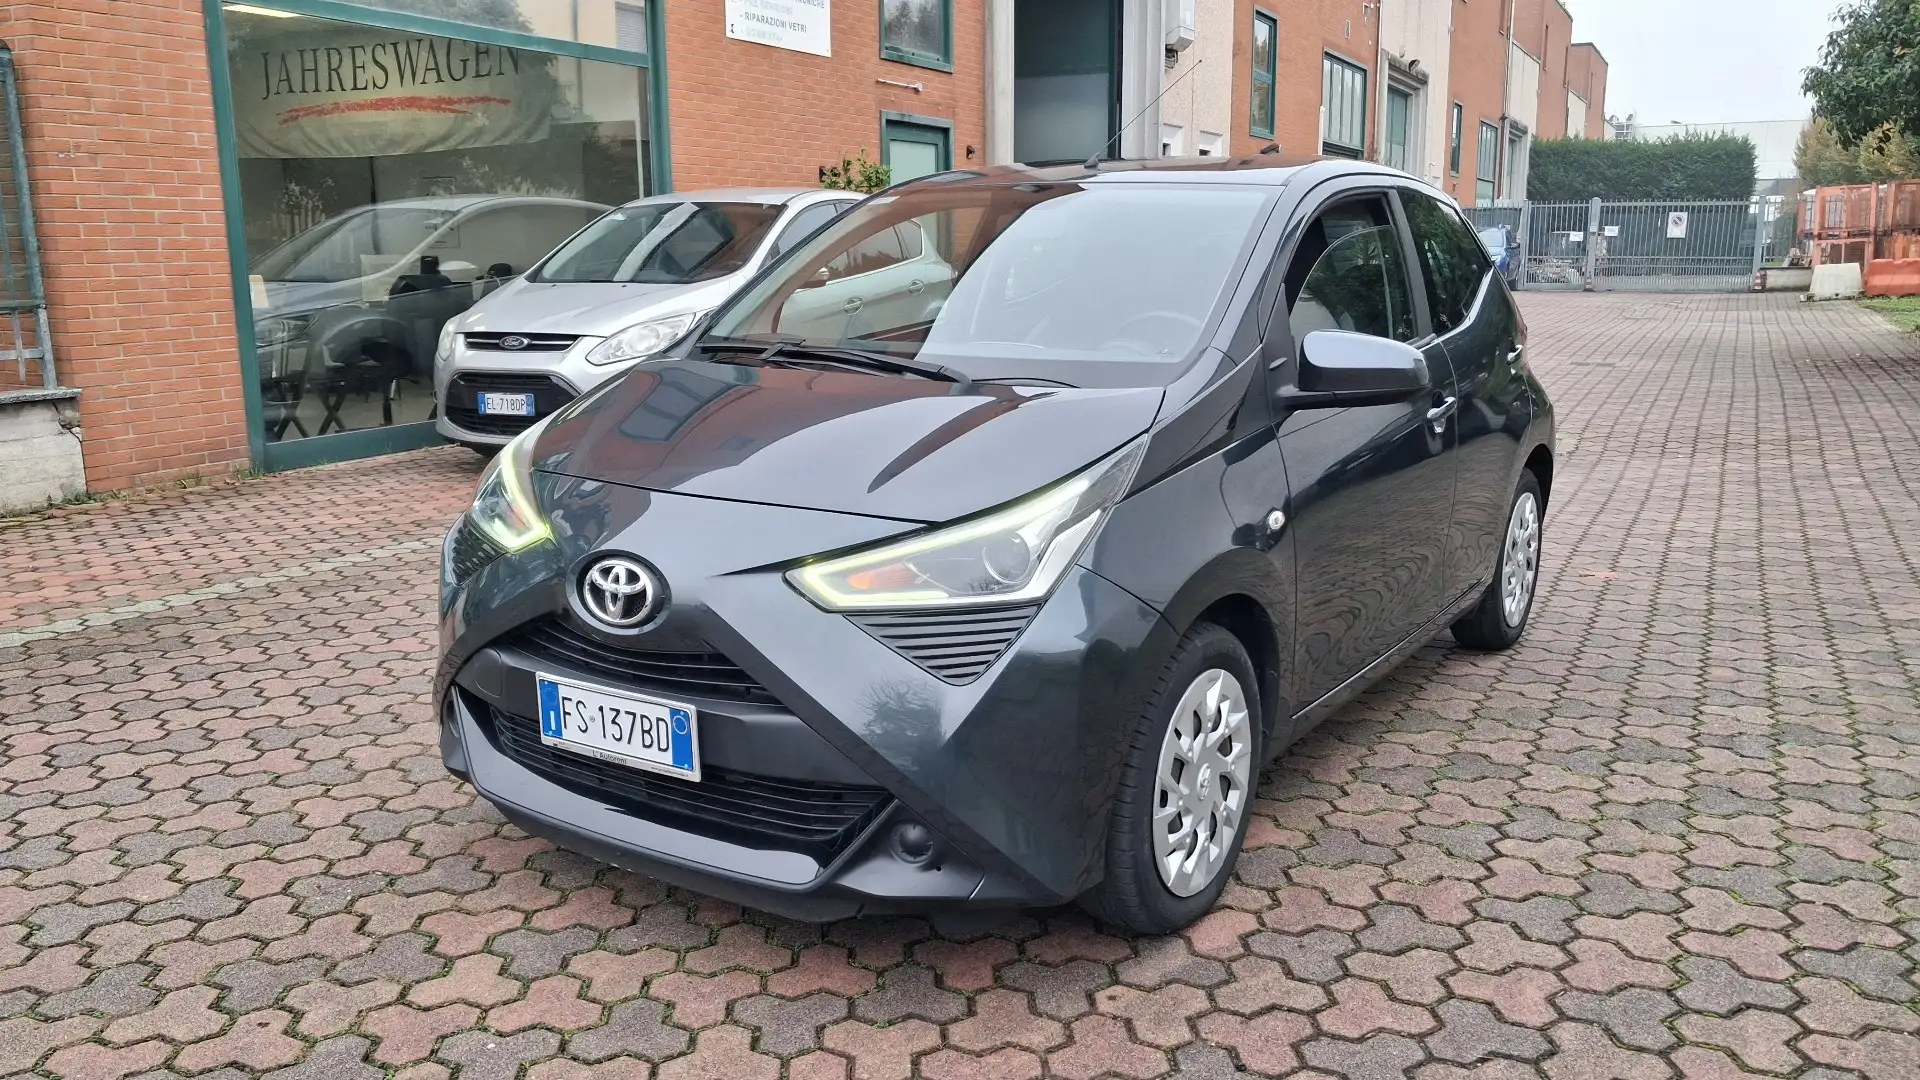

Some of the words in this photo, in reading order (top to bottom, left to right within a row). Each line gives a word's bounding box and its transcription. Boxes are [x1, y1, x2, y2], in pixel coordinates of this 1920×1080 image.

[744, 12, 787, 28] RIPARAZIONI
[788, 22, 807, 33] VETRI
[261, 38, 522, 101] JAHRESWAGEN
[561, 696, 588, 733] FS
[598, 705, 670, 752] 137BD
